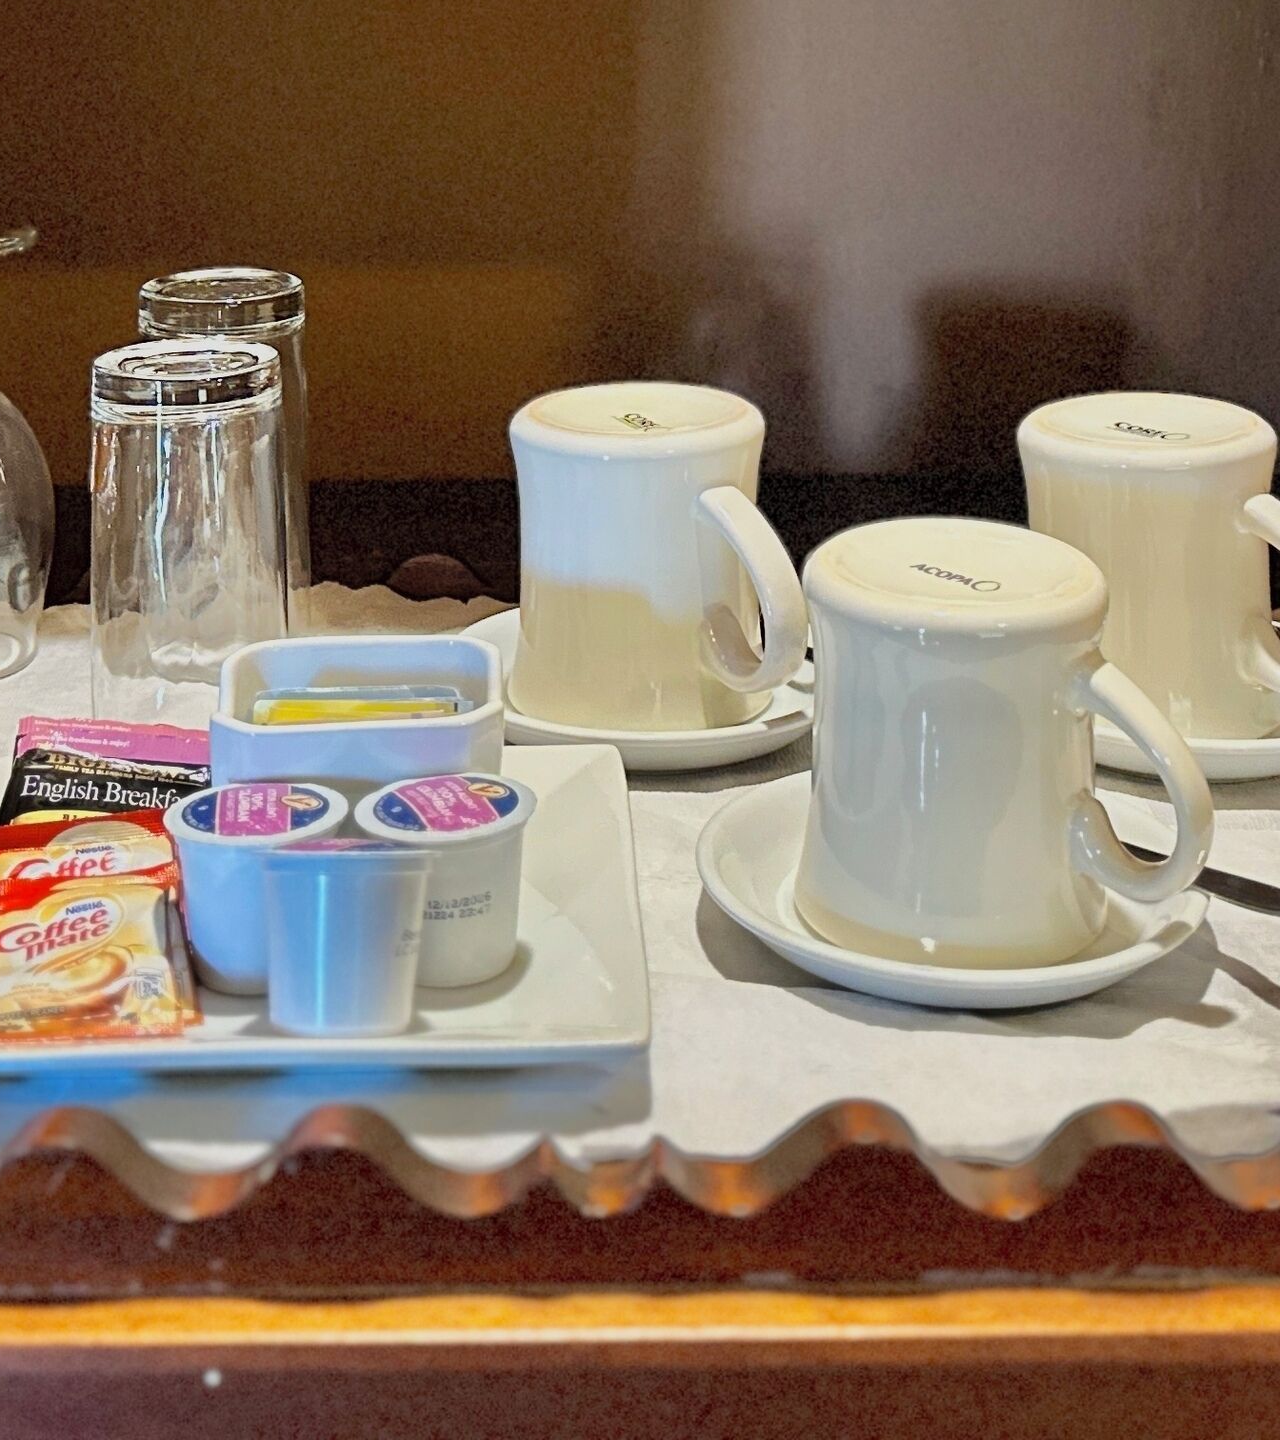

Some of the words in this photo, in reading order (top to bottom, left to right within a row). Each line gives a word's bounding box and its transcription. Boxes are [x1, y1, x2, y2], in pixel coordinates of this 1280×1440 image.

[20, 774, 100, 803] English
[104, 780, 182, 810] Breakfa
[7, 851, 117, 879] Cffee
[25, 923, 111, 962] mate
